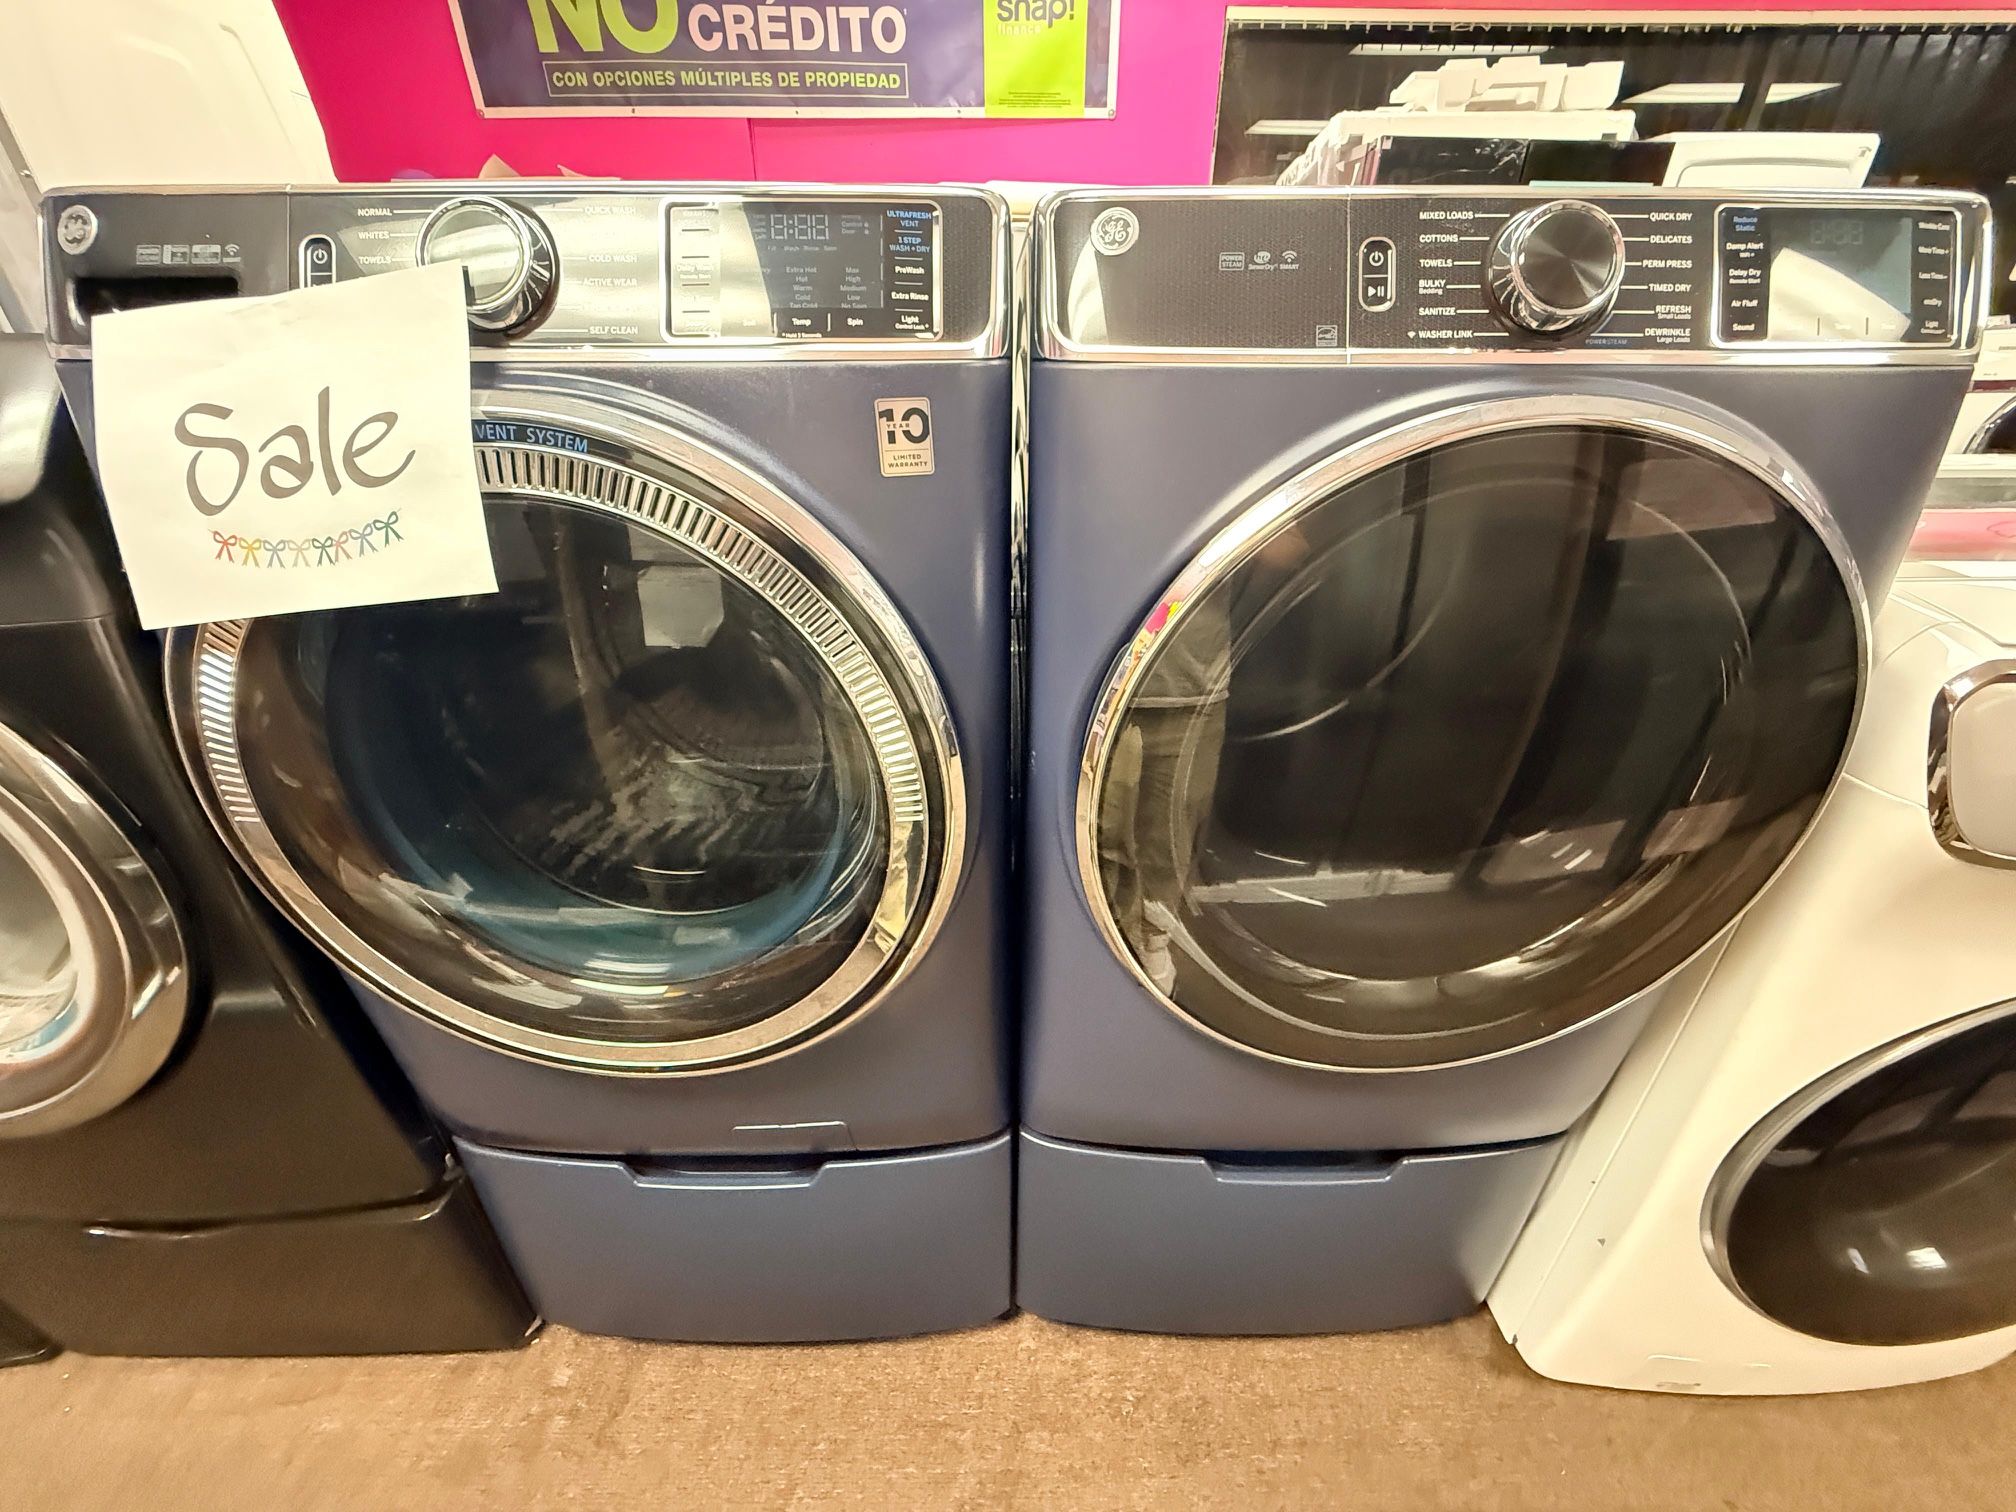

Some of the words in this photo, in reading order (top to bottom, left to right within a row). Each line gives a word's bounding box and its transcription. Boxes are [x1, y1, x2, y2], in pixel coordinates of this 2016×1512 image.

[526, 0, 679, 54] NO
[688, 0, 907, 54] CRÉDITO
[552, 71, 588, 88] CON
[592, 70, 676, 87] OPCIONES
[681, 67, 773, 88] MÚLTIPLES
[778, 71, 801, 88] DE
[804, 71, 901, 89] PROPIEDAD
[357, 207, 393, 217] NORMAL
[886, 210, 932, 220] ULTRAFRESH
[1419, 211, 1446, 220] MIXED
[1446, 211, 1474, 220] LOADS
[1649, 211, 1674, 222] QUICK
[1675, 212, 1693, 221] DRY
[900, 220, 920, 228] VENT
[358, 230, 390, 240] WHITES
[1419, 234, 1459, 243] COTTONS
[1649, 235, 1693, 244] DELICATES
[904, 237, 922, 245] STEP
[889, 244, 911, 252] WASH
[916, 245, 931, 253] DRY
[1726, 242, 1747, 251] Damp
[1747, 242, 1765, 250] Alert
[358, 255, 392, 265] TOWELS
[589, 254, 611, 263] COLD
[612, 254, 638, 263] WASH
[1419, 258, 1453, 267] TOWELS
[1642, 259, 1665, 268] PERM
[1666, 259, 1693, 268] PRESS
[894, 265, 925, 275] PreWash
[1729, 268, 1748, 278] Delay
[1748, 268, 1762, 277] Dry
[1418, 279, 1446, 289] BULKY
[1648, 282, 1674, 292] TIMED
[1674, 282, 1692, 292] DRY
[891, 291, 909, 301] Extra
[909, 292, 929, 302] Rinse
[1418, 307, 1456, 316] SANITIZE
[1655, 304, 1692, 314] REFRESH
[792, 317, 812, 327] Temp
[847, 317, 864, 327] Spin
[901, 315, 920, 325] Light
[589, 325, 609, 335] SELF
[610, 325, 639, 335] CLEAN
[1732, 323, 1756, 331] Sound
[1418, 330, 1453, 339] WASHER
[1454, 330, 1474, 338] LINK
[1643, 328, 1692, 338] DEWRINKLE
[879, 406, 930, 445] 10
[474, 424, 517, 441] VENT
[526, 427, 588, 453] SYSTEM
[174, 385, 416, 516] Sale
[893, 453, 922, 461] LIMITED
[887, 460, 929, 469] WARRANTY
